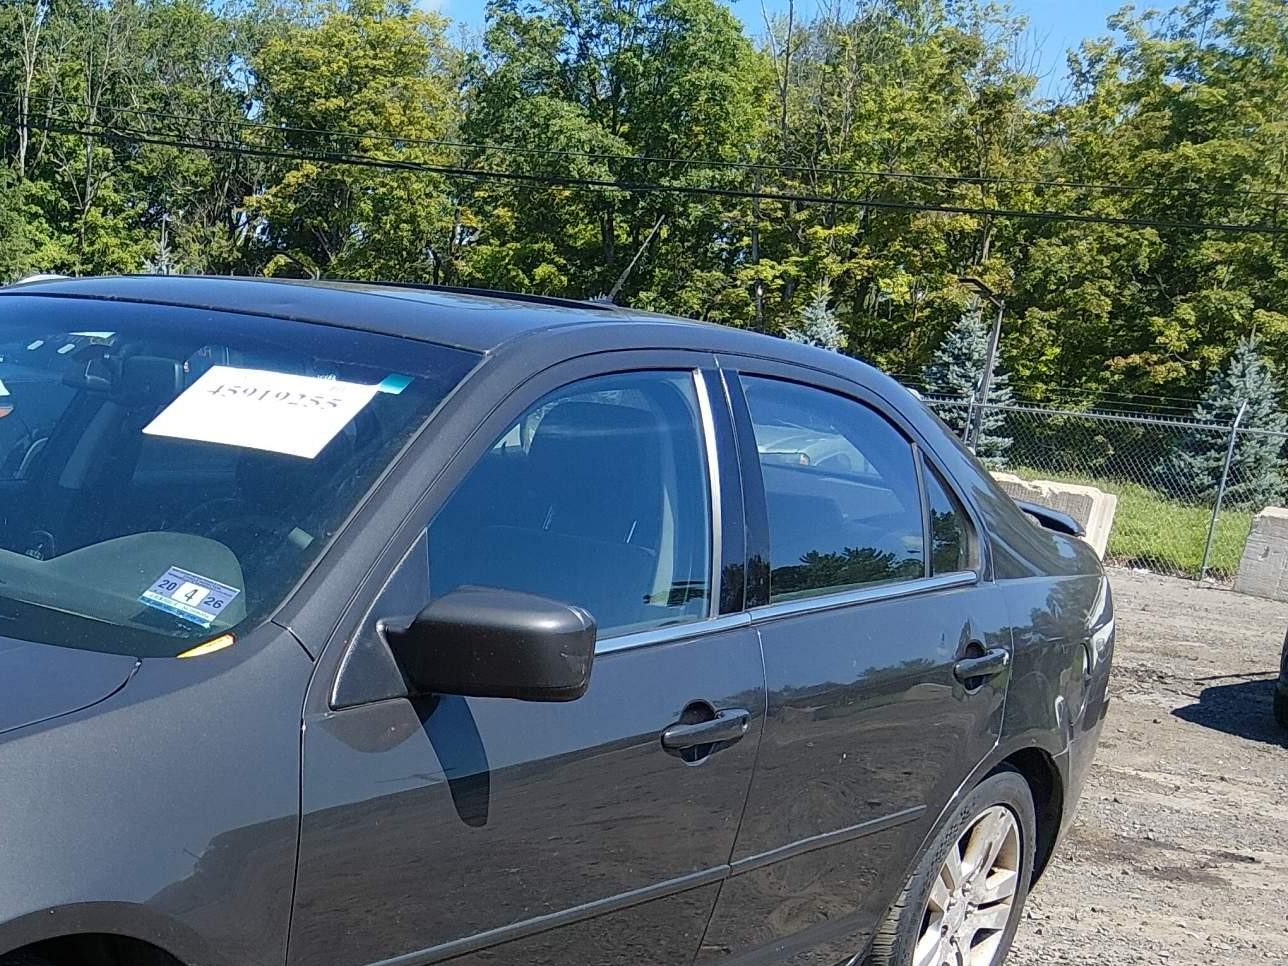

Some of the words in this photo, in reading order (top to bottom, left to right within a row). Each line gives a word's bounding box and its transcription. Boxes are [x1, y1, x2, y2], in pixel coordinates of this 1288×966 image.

[157, 579, 178, 592] 20
[184, 588, 199, 602] 4
[203, 596, 224, 609] 26
